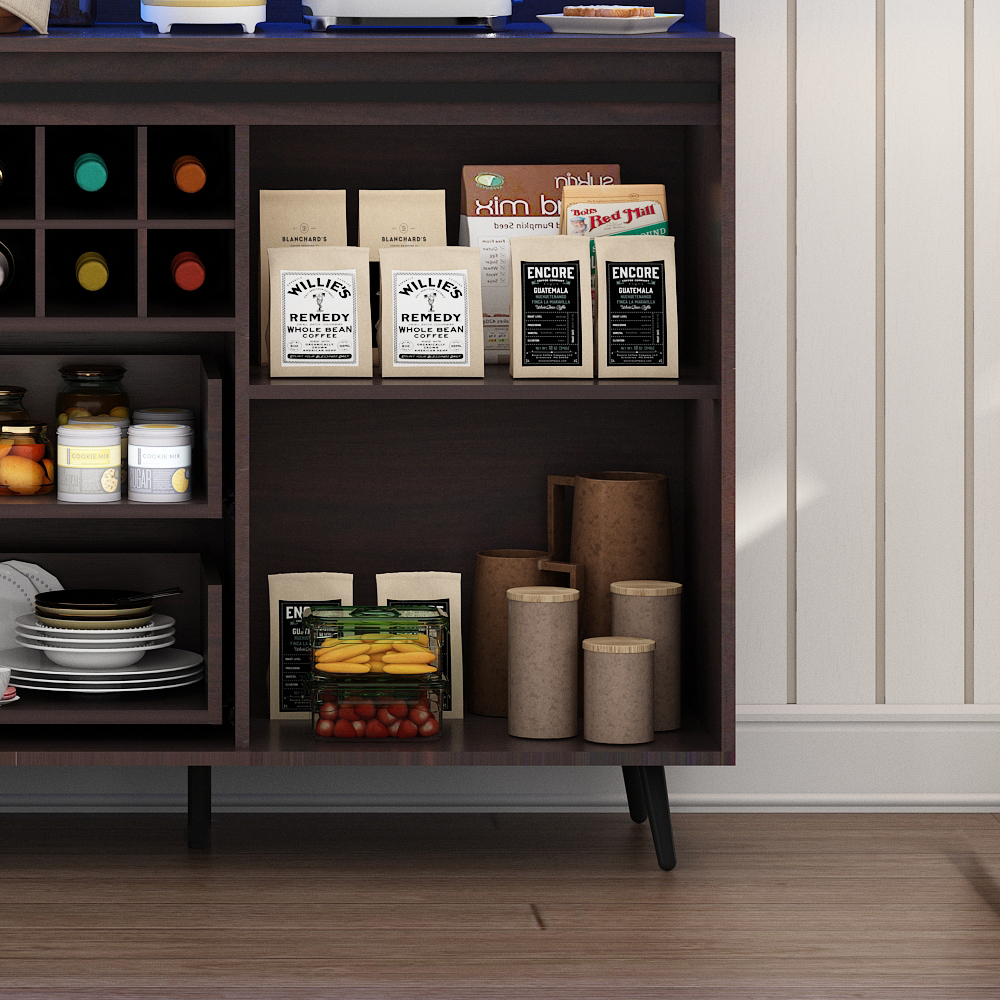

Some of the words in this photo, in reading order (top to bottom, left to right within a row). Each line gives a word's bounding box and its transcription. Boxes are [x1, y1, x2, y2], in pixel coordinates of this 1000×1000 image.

[589, 209, 621, 233] Red
[622, 203, 656, 224] Mill
[527, 266, 575, 279] ENCORE
[612, 266, 660, 279] ENCORE
[287, 277, 352, 299] WILLIE'S
[398, 277, 463, 299] WILLIE'S
[289, 313, 350, 322] REMEDY
[401, 313, 462, 322] REMEDY
[287, 325, 322, 333] WHOLE
[325, 325, 352, 333] BEAN
[399, 325, 434, 333] WHOLE
[437, 325, 464, 333] BEAN
